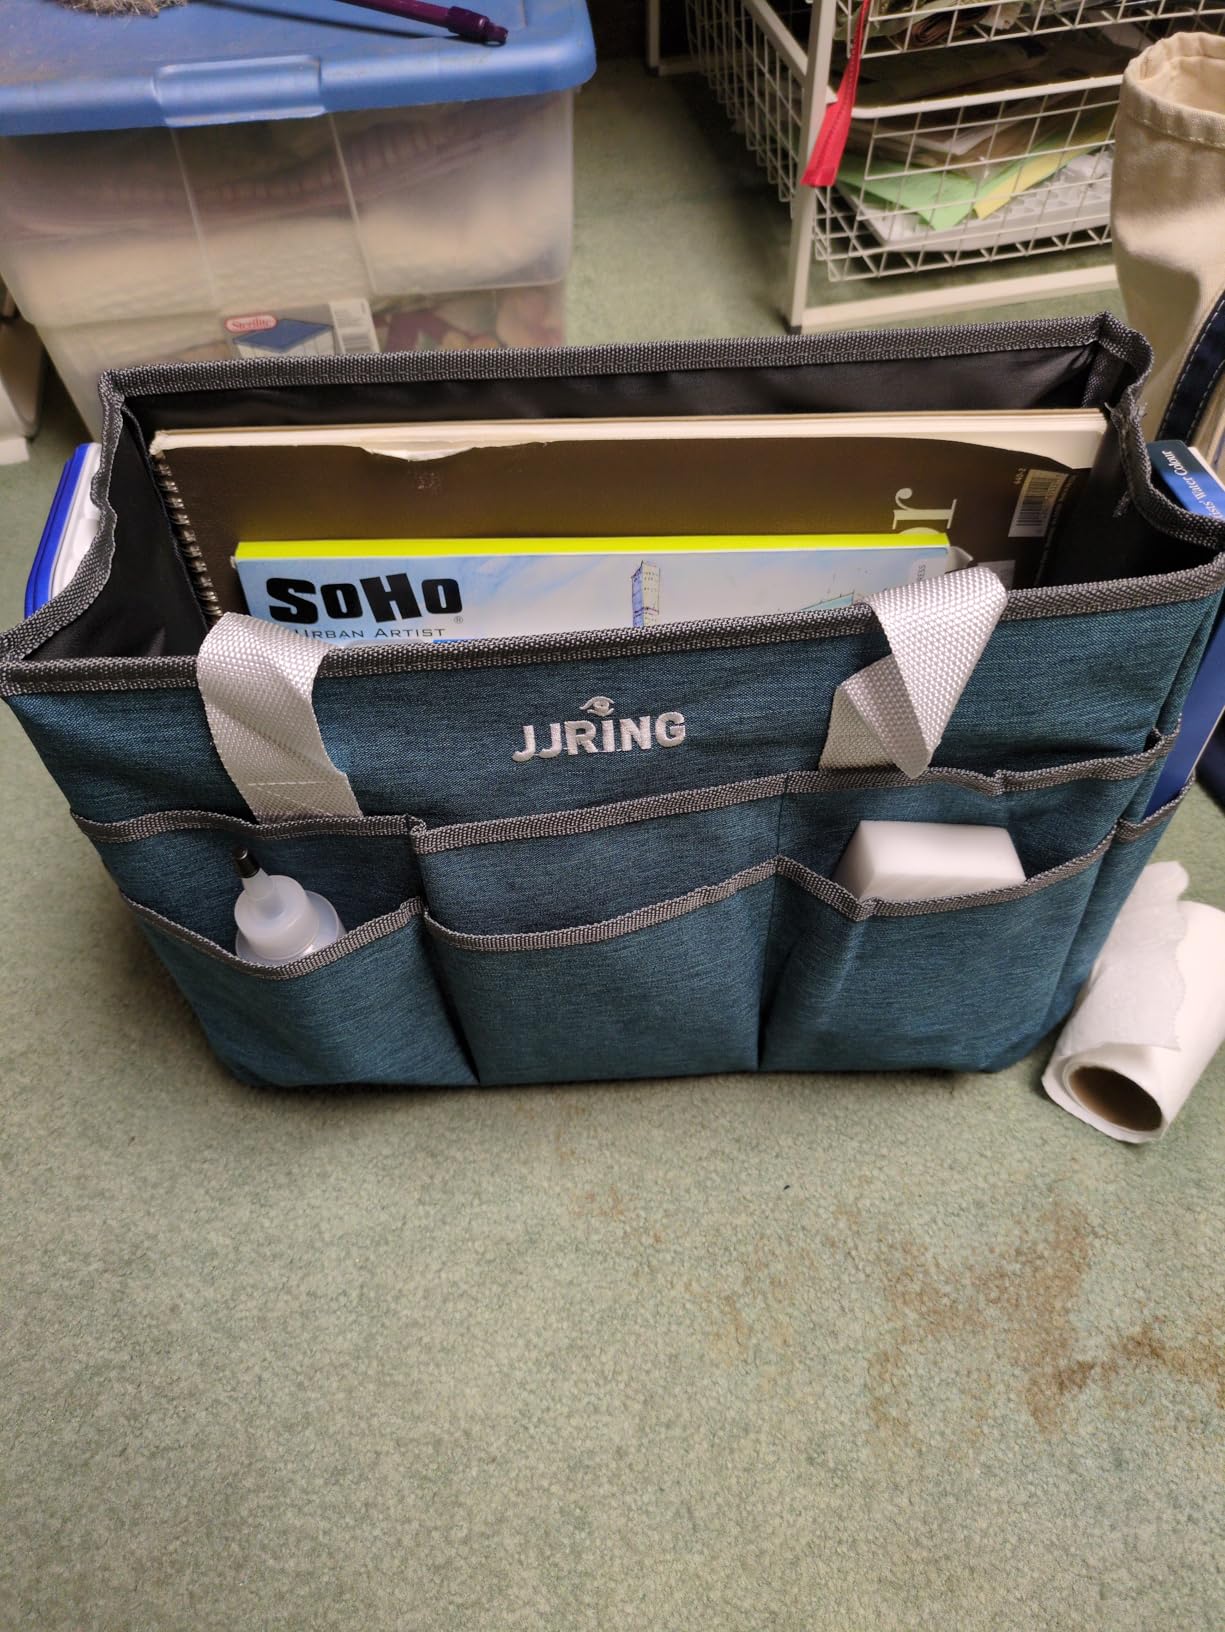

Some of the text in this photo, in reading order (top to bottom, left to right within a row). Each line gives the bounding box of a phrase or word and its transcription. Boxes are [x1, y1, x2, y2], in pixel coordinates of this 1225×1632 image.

[1161, 450, 1188, 476] Colour
[1183, 475, 1207, 501] Water
[374, 628, 447, 639] ARTIST
